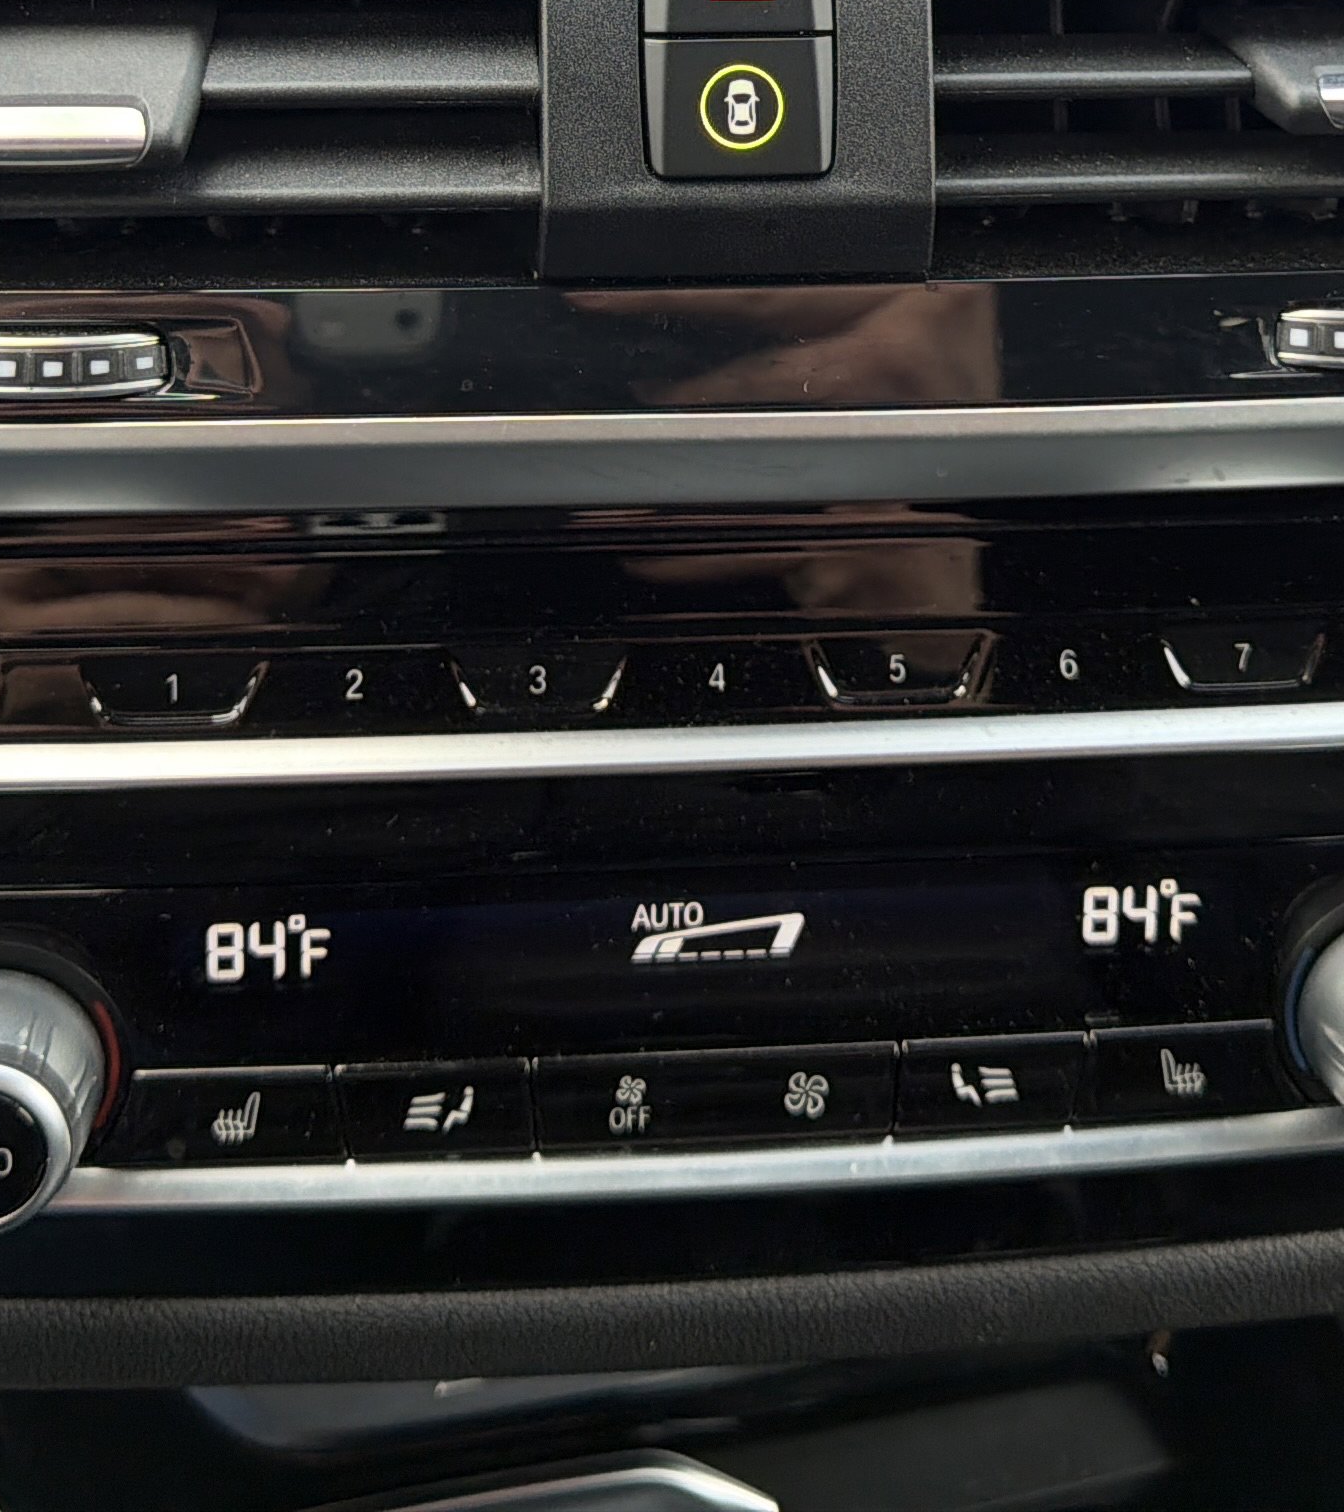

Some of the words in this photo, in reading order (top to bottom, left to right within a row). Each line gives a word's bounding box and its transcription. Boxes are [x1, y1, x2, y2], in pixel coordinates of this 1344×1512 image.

[164, 673, 179, 704] 1
[344, 668, 365, 701] 2
[528, 664, 548, 695] 3
[707, 662, 727, 693] 4
[888, 653, 908, 684] 5
[1058, 649, 1082, 681] 6
[1232, 642, 1253, 673] 7
[630, 901, 705, 931] AUTO
[608, 1105, 653, 1136] OFF
